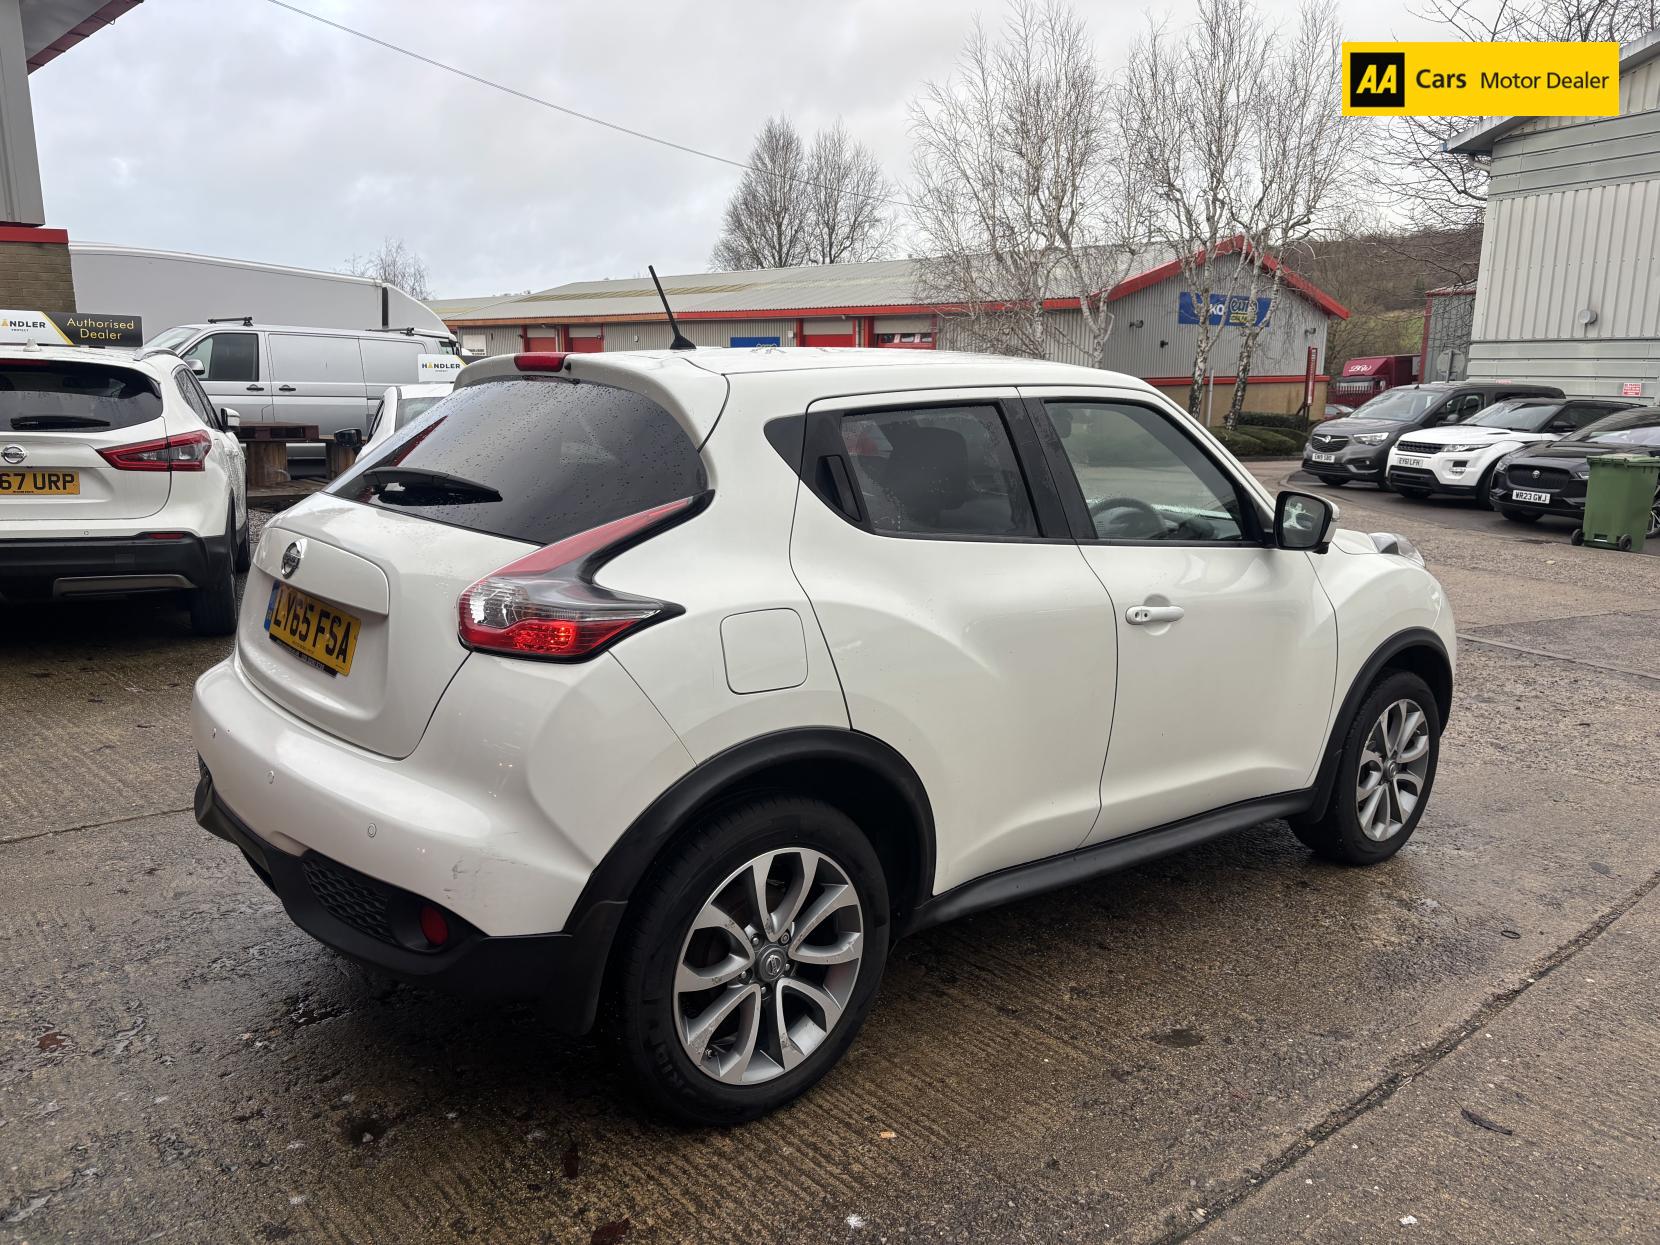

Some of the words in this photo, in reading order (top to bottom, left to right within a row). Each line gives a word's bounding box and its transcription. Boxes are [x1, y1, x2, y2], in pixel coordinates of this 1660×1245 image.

[66, 318, 134, 330] Authorised
[80, 328, 121, 340] Dealer
[33, 473, 75, 490] URP
[1515, 491, 1532, 500] WR23
[273, 583, 314, 642] LY65
[312, 608, 352, 664] FSA
